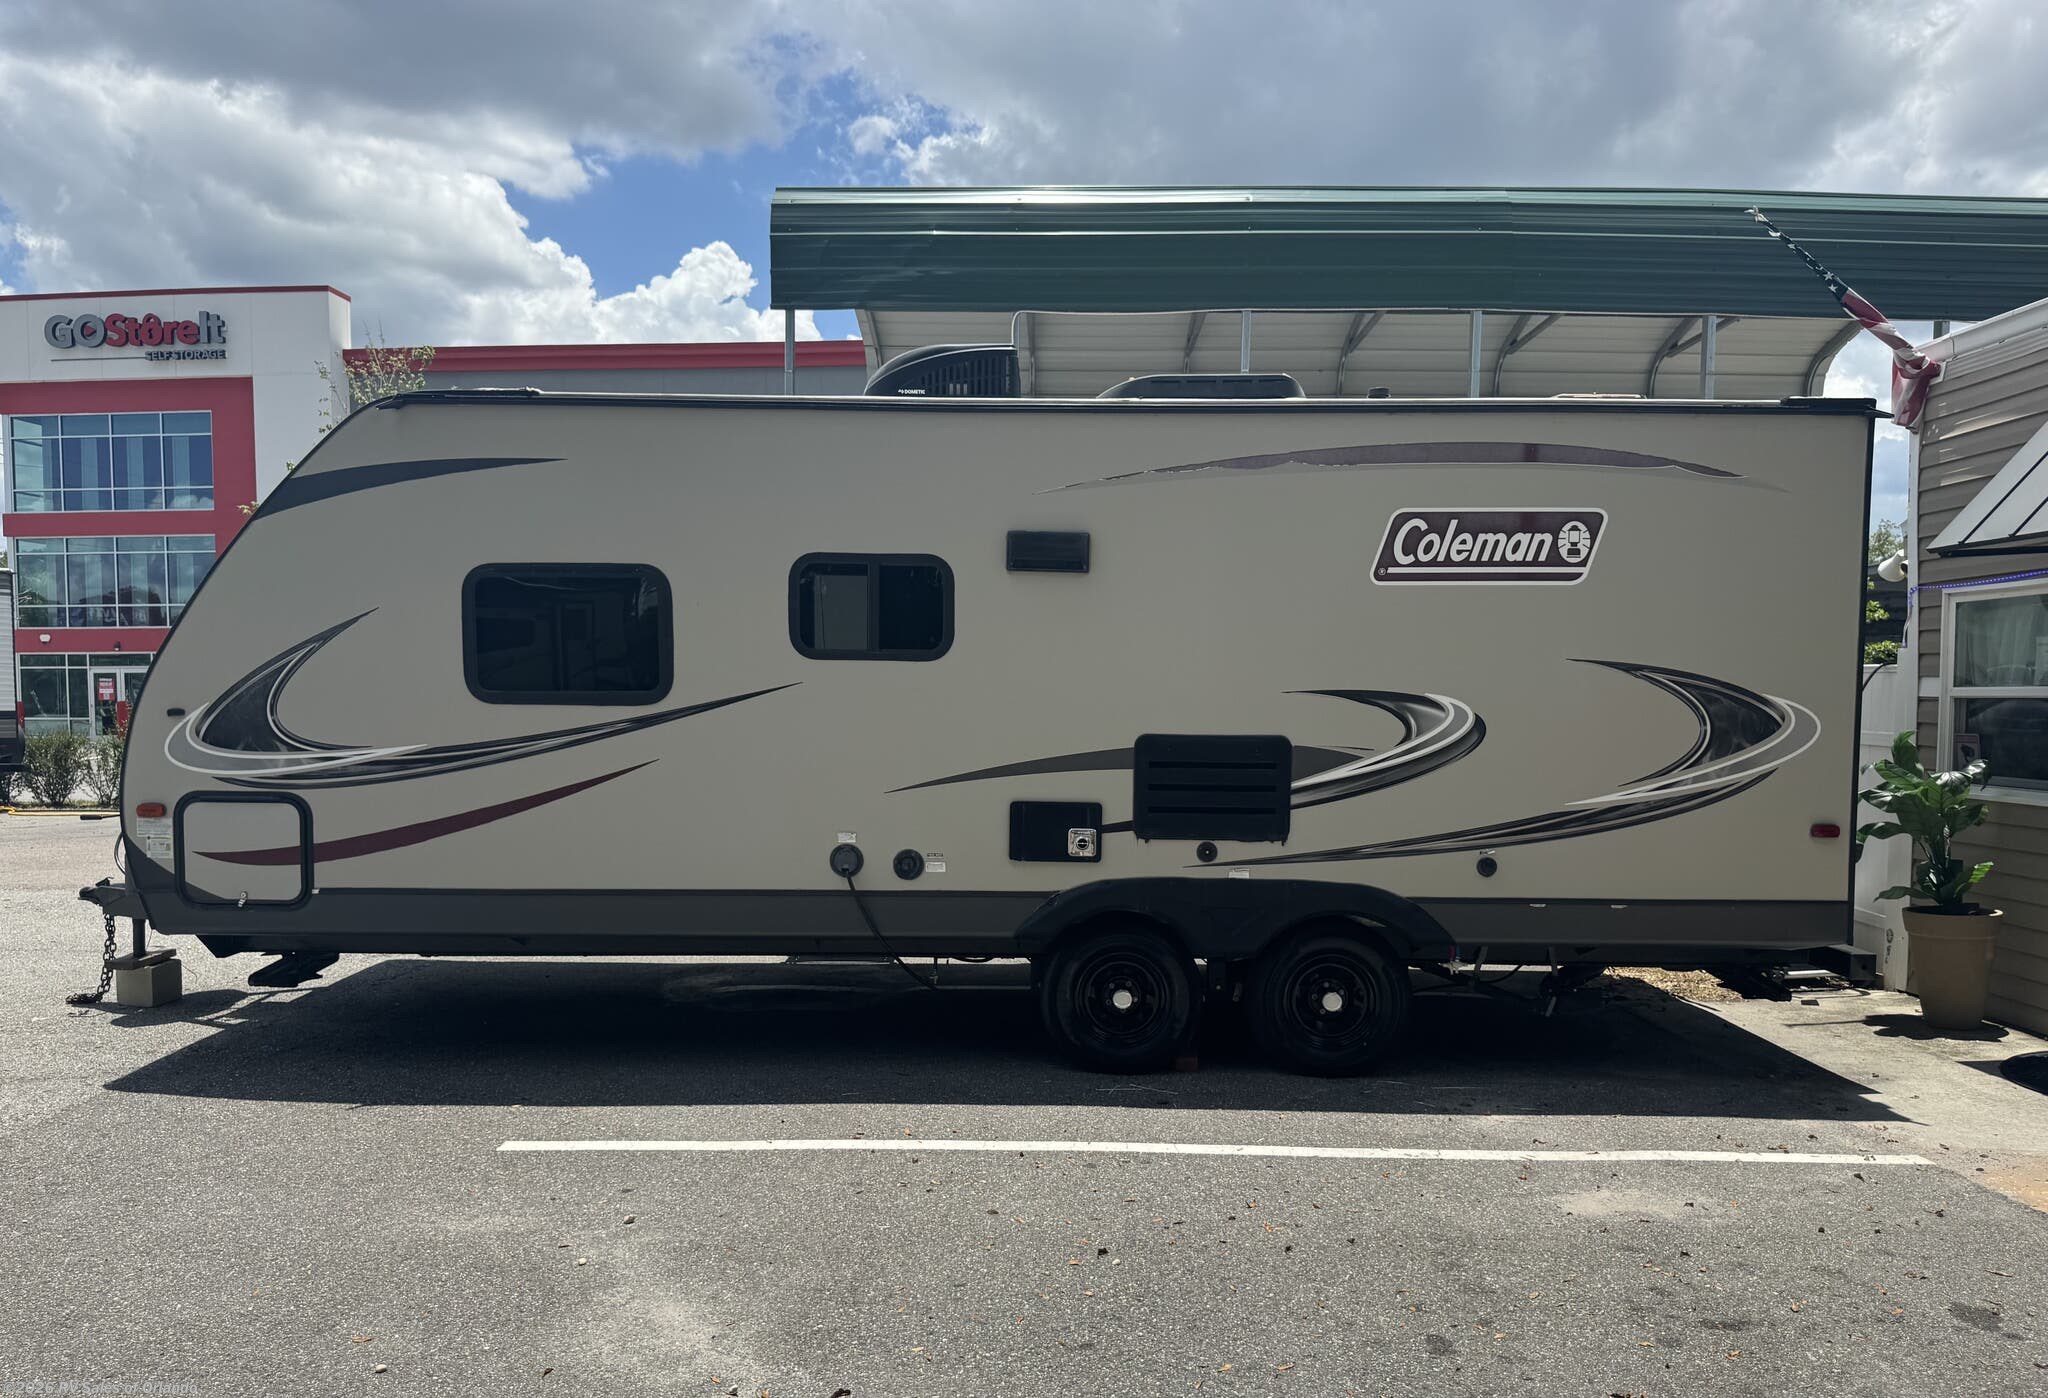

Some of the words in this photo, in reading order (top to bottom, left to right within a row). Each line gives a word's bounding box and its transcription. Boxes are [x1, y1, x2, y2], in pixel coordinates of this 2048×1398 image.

[145, 351, 170, 361] SELF
[170, 349, 227, 361] STORAGE
[1393, 518, 1553, 565] Coleman
